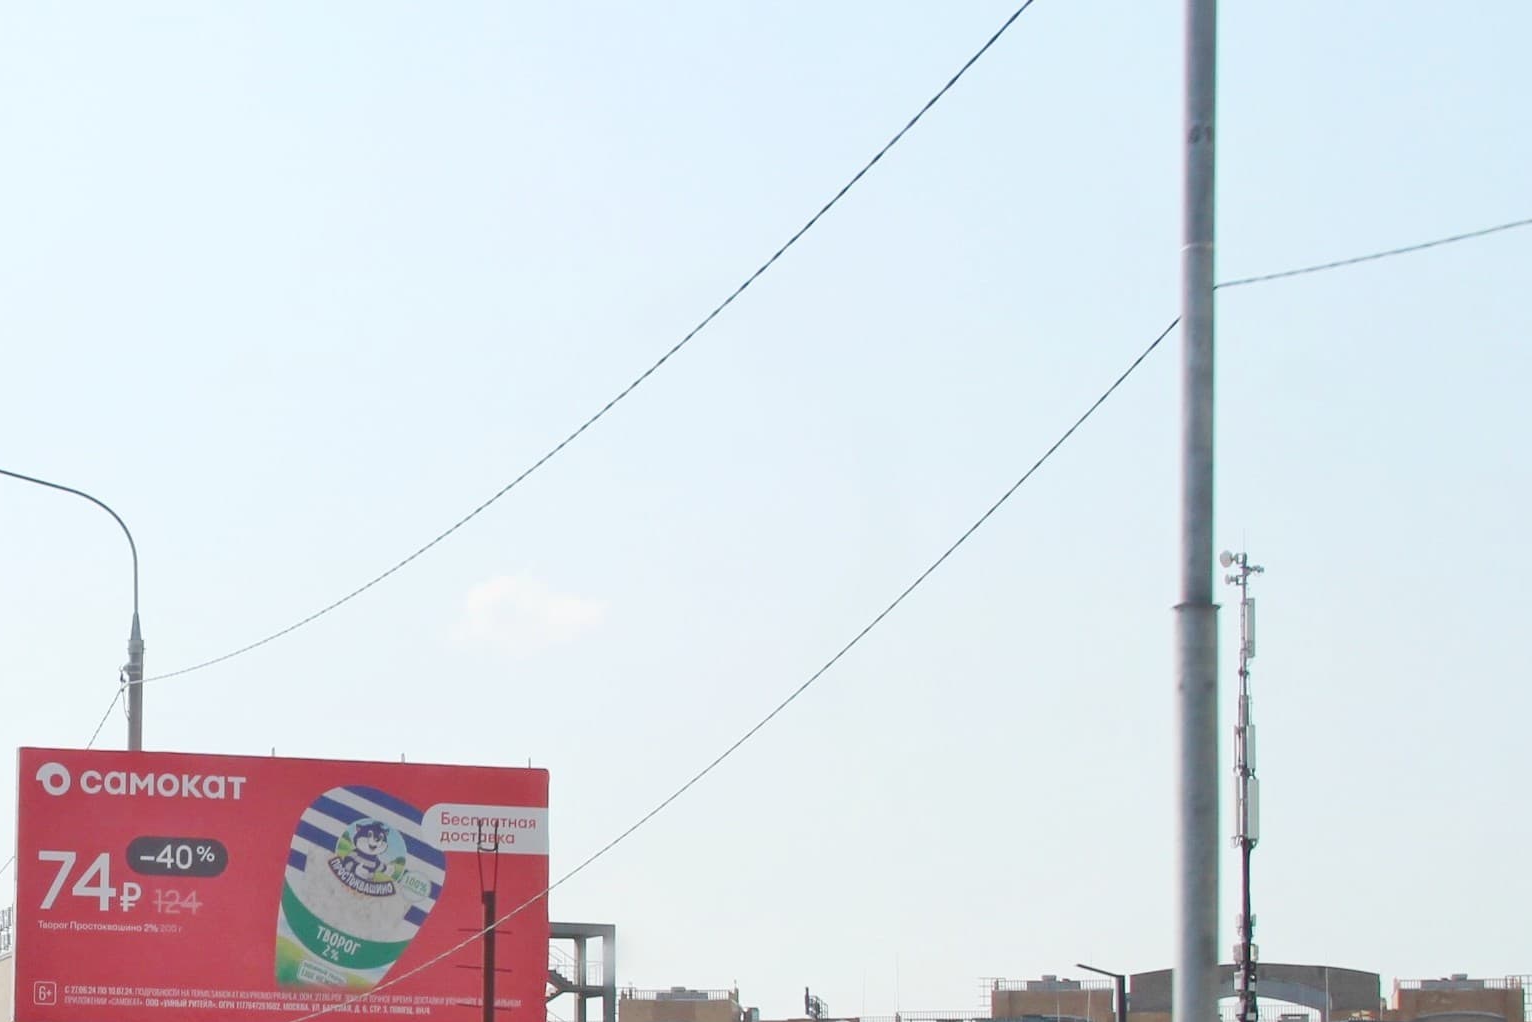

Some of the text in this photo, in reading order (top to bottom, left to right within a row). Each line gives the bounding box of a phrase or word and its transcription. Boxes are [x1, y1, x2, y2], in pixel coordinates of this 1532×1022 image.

[79, 769, 247, 800] самокат
[440, 810, 537, 830] Бесплатная
[439, 830, 515, 845] доставка
[328, 856, 396, 896] ПРОСТОКВАШИНО
[152, 888, 203, 915] 124
[38, 919, 68, 930] Творог
[69, 920, 143, 933] Простоквашино
[143, 923, 159, 933] 2%
[316, 926, 361, 956] ТВОРОГ
[321, 945, 340, 962] 2%
[38, 985, 53, 1001] 6+
